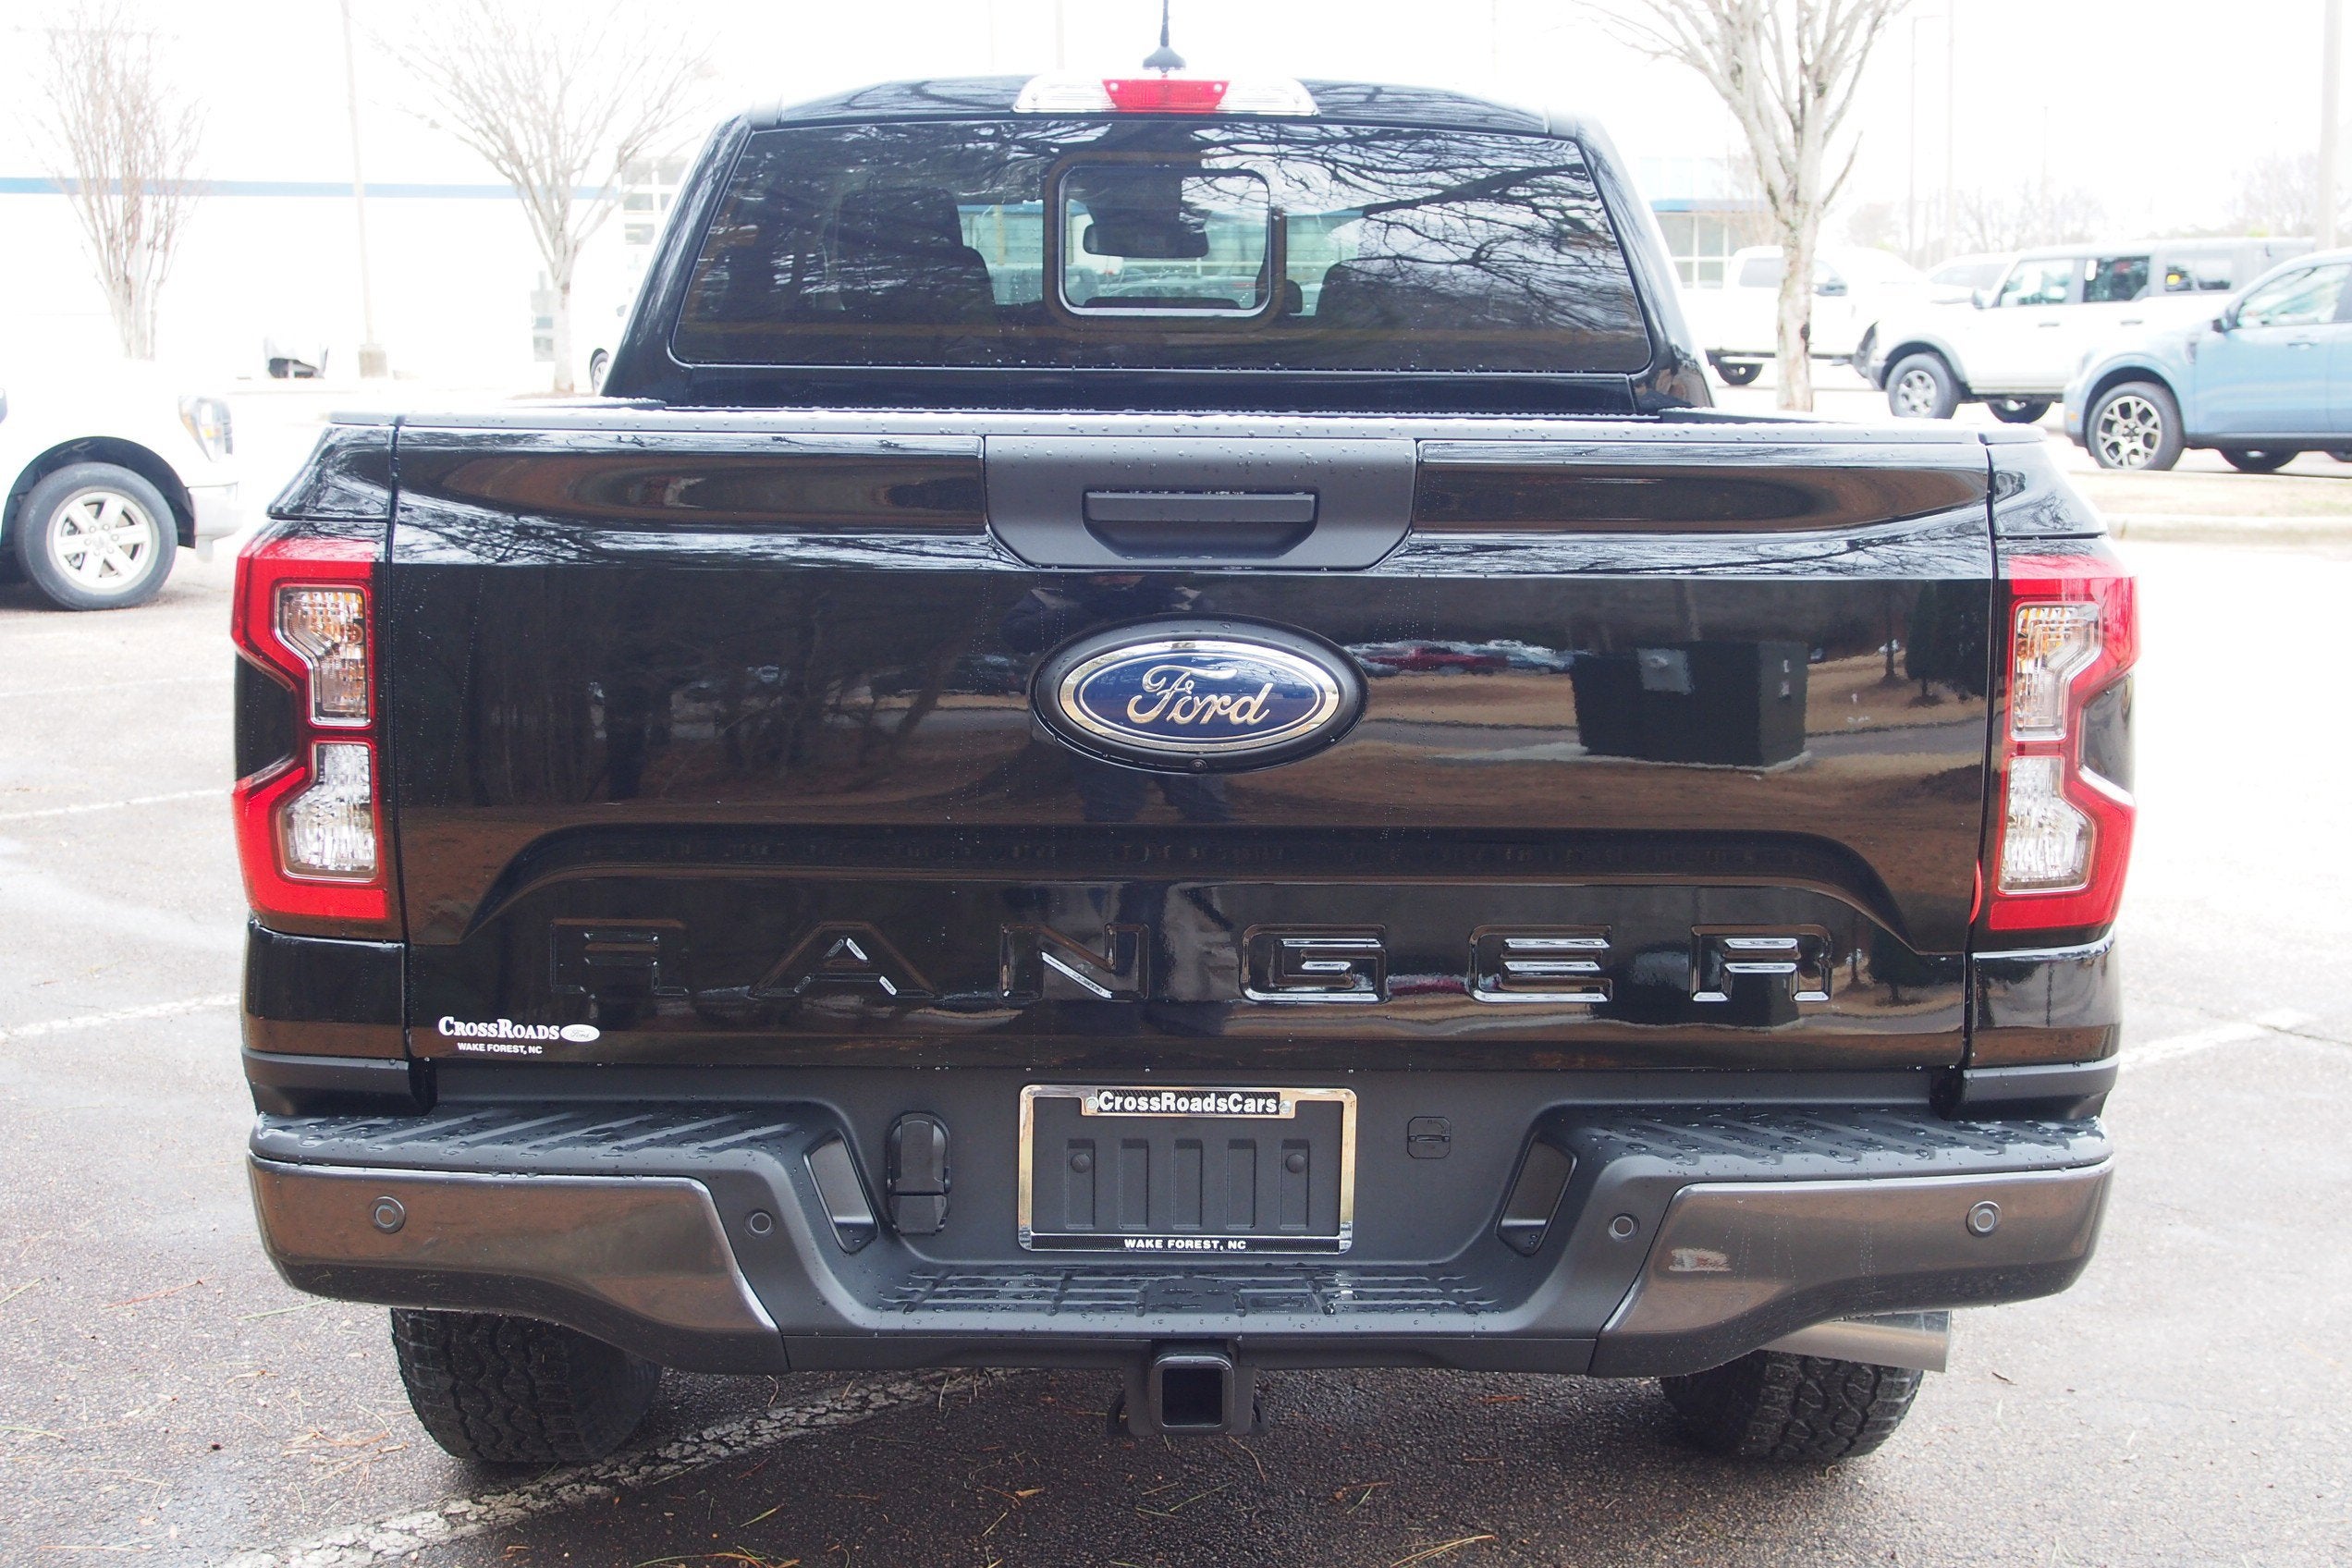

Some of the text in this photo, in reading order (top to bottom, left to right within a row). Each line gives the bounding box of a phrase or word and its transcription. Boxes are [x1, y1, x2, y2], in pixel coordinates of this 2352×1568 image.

[1127, 665, 1274, 725] Ford
[550, 918, 1833, 1003] RANGER
[458, 1042, 543, 1055] WAKE FOREST, NC
[1098, 1092, 1277, 1113] CrossRoadsCars
[1124, 1239, 1246, 1251] WAKE FOREST, NC
